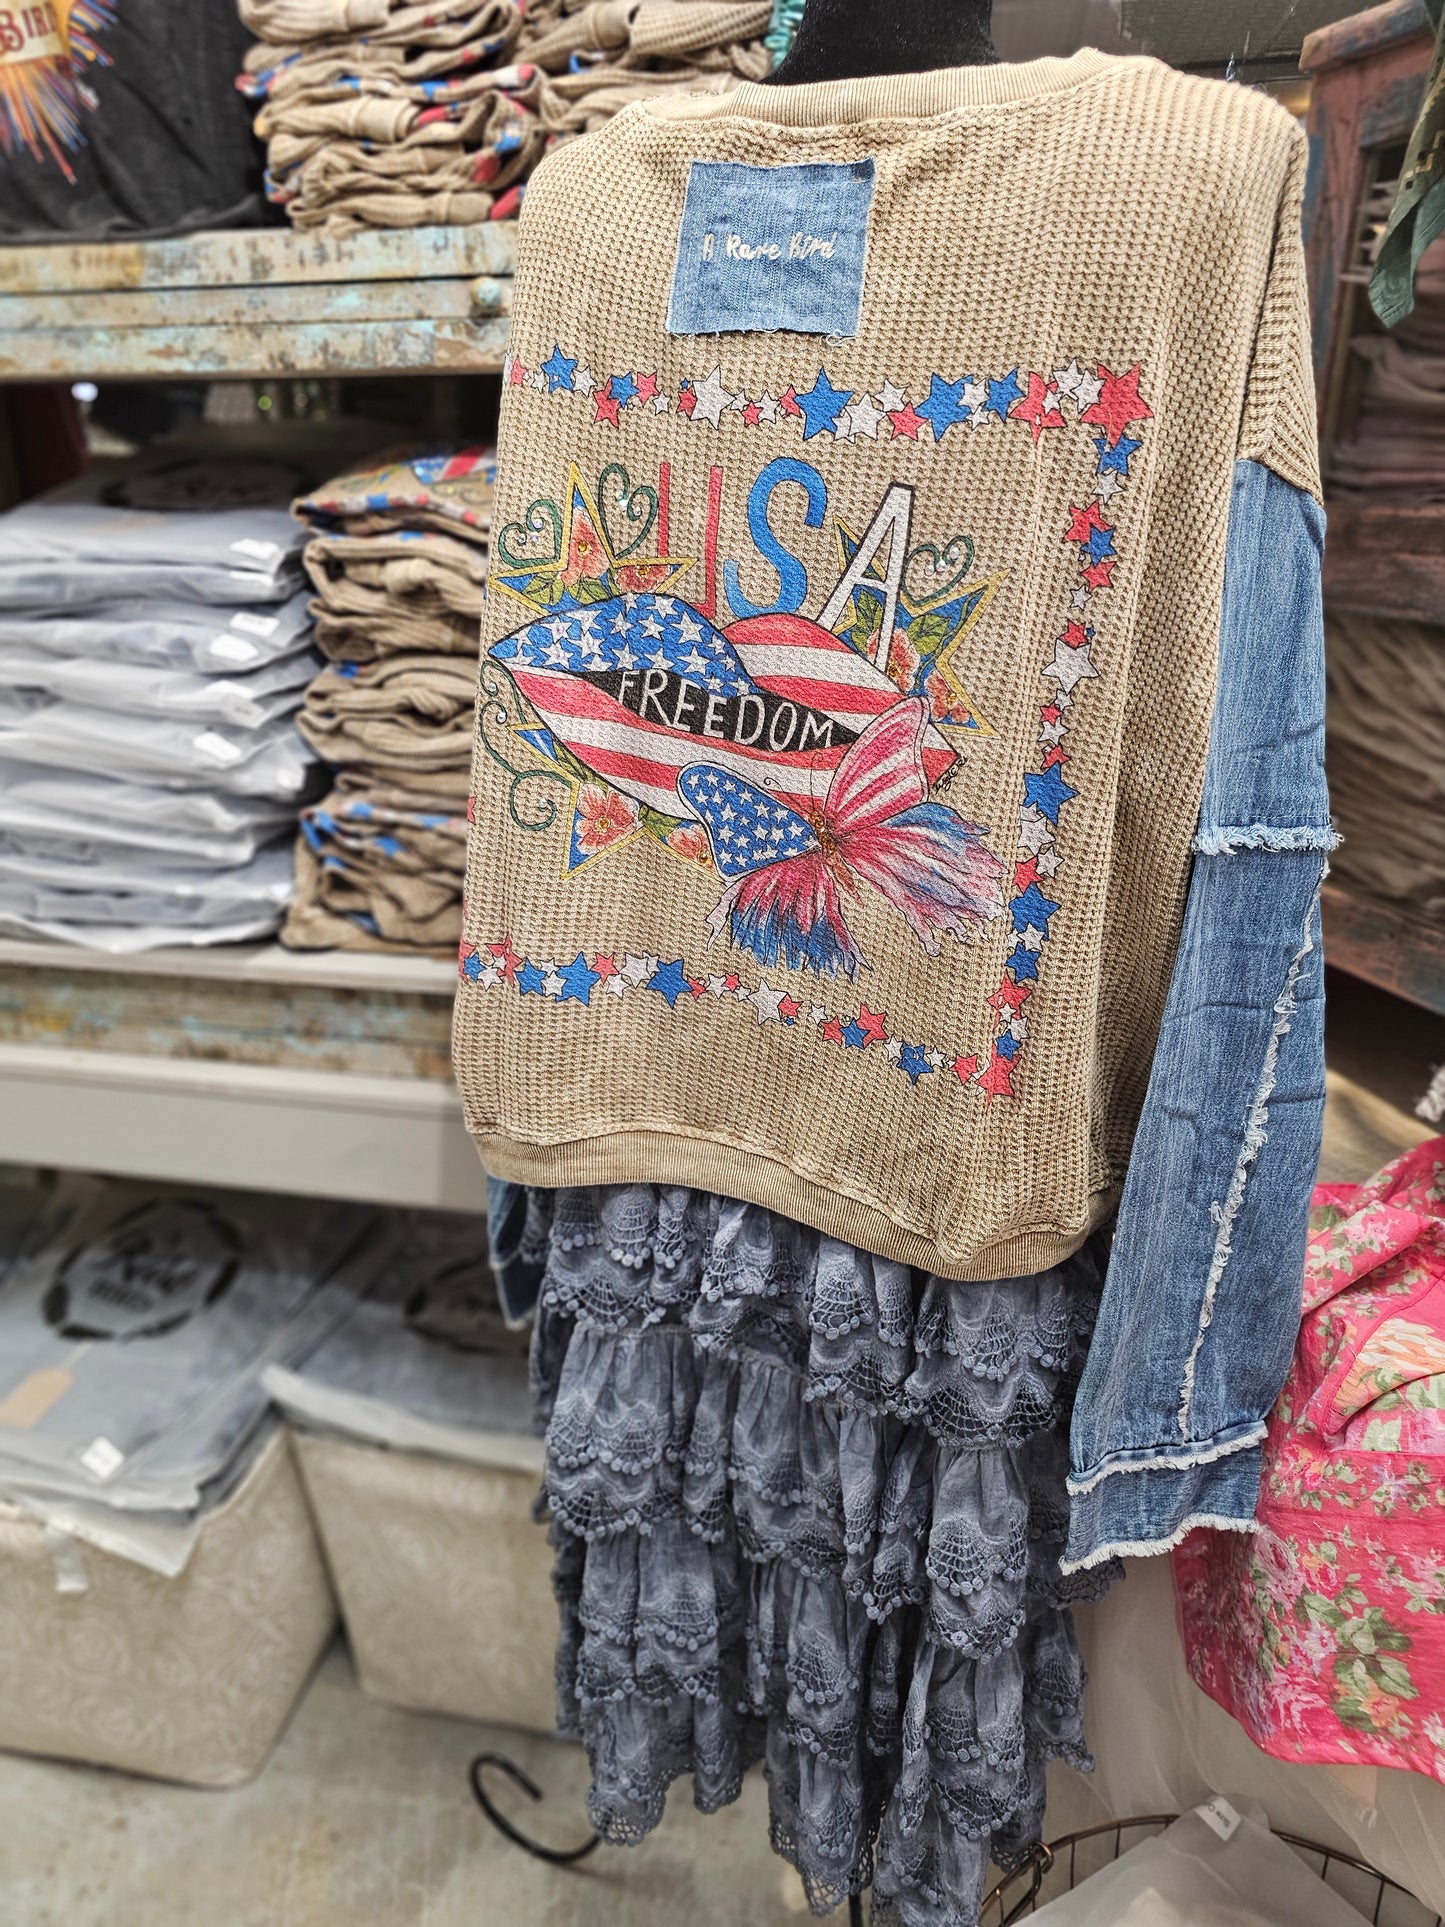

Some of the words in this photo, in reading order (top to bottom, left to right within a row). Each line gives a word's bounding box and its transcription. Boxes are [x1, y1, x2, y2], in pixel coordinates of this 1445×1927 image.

[726, 232, 782, 260] Rare
[788, 231, 838, 260] Bird
[618, 669, 836, 751] FREEDOM
